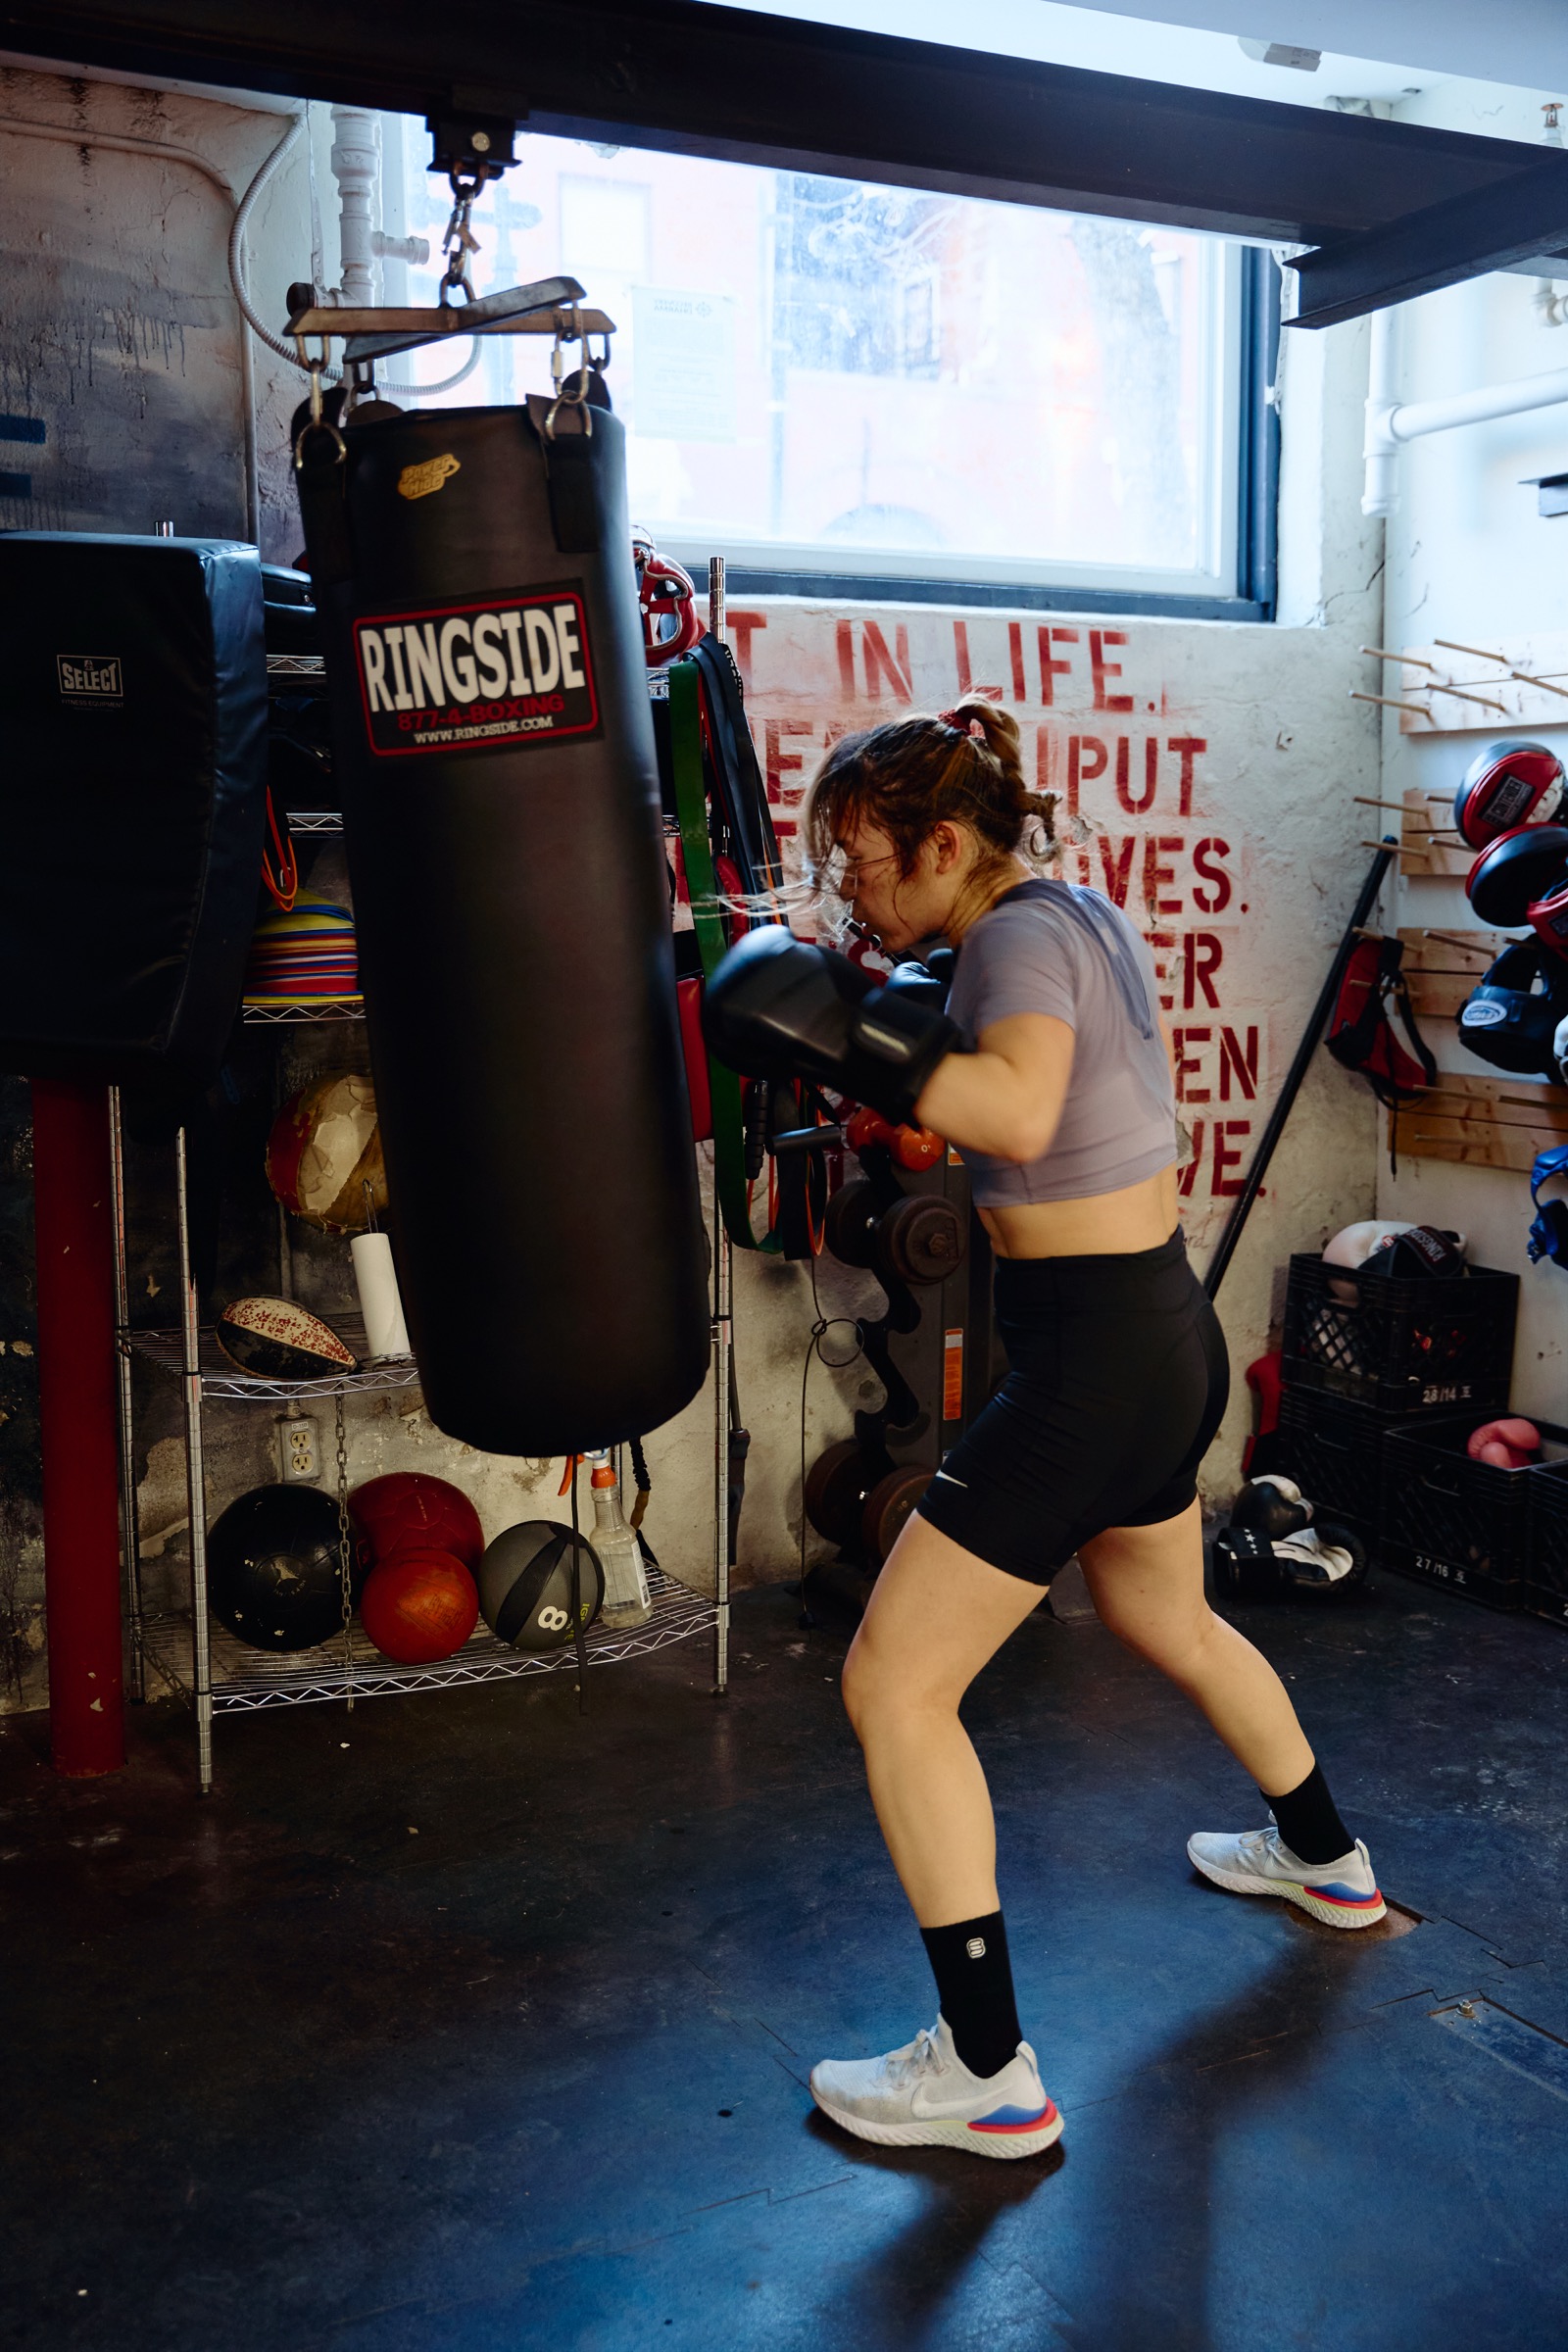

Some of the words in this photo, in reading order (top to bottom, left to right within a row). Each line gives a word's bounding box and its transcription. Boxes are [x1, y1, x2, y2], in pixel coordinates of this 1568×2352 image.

[360, 604, 585, 712] RINGSIDE
[837, 618, 913, 706] IN
[953, 619, 1155, 712] LIFE.
[62, 662, 117, 692] SELECT
[397, 694, 565, 731] 877-4-BOXING
[414, 715, 554, 744] WWW.RINGSIDE.COM
[537, 1605, 568, 1632] 8
